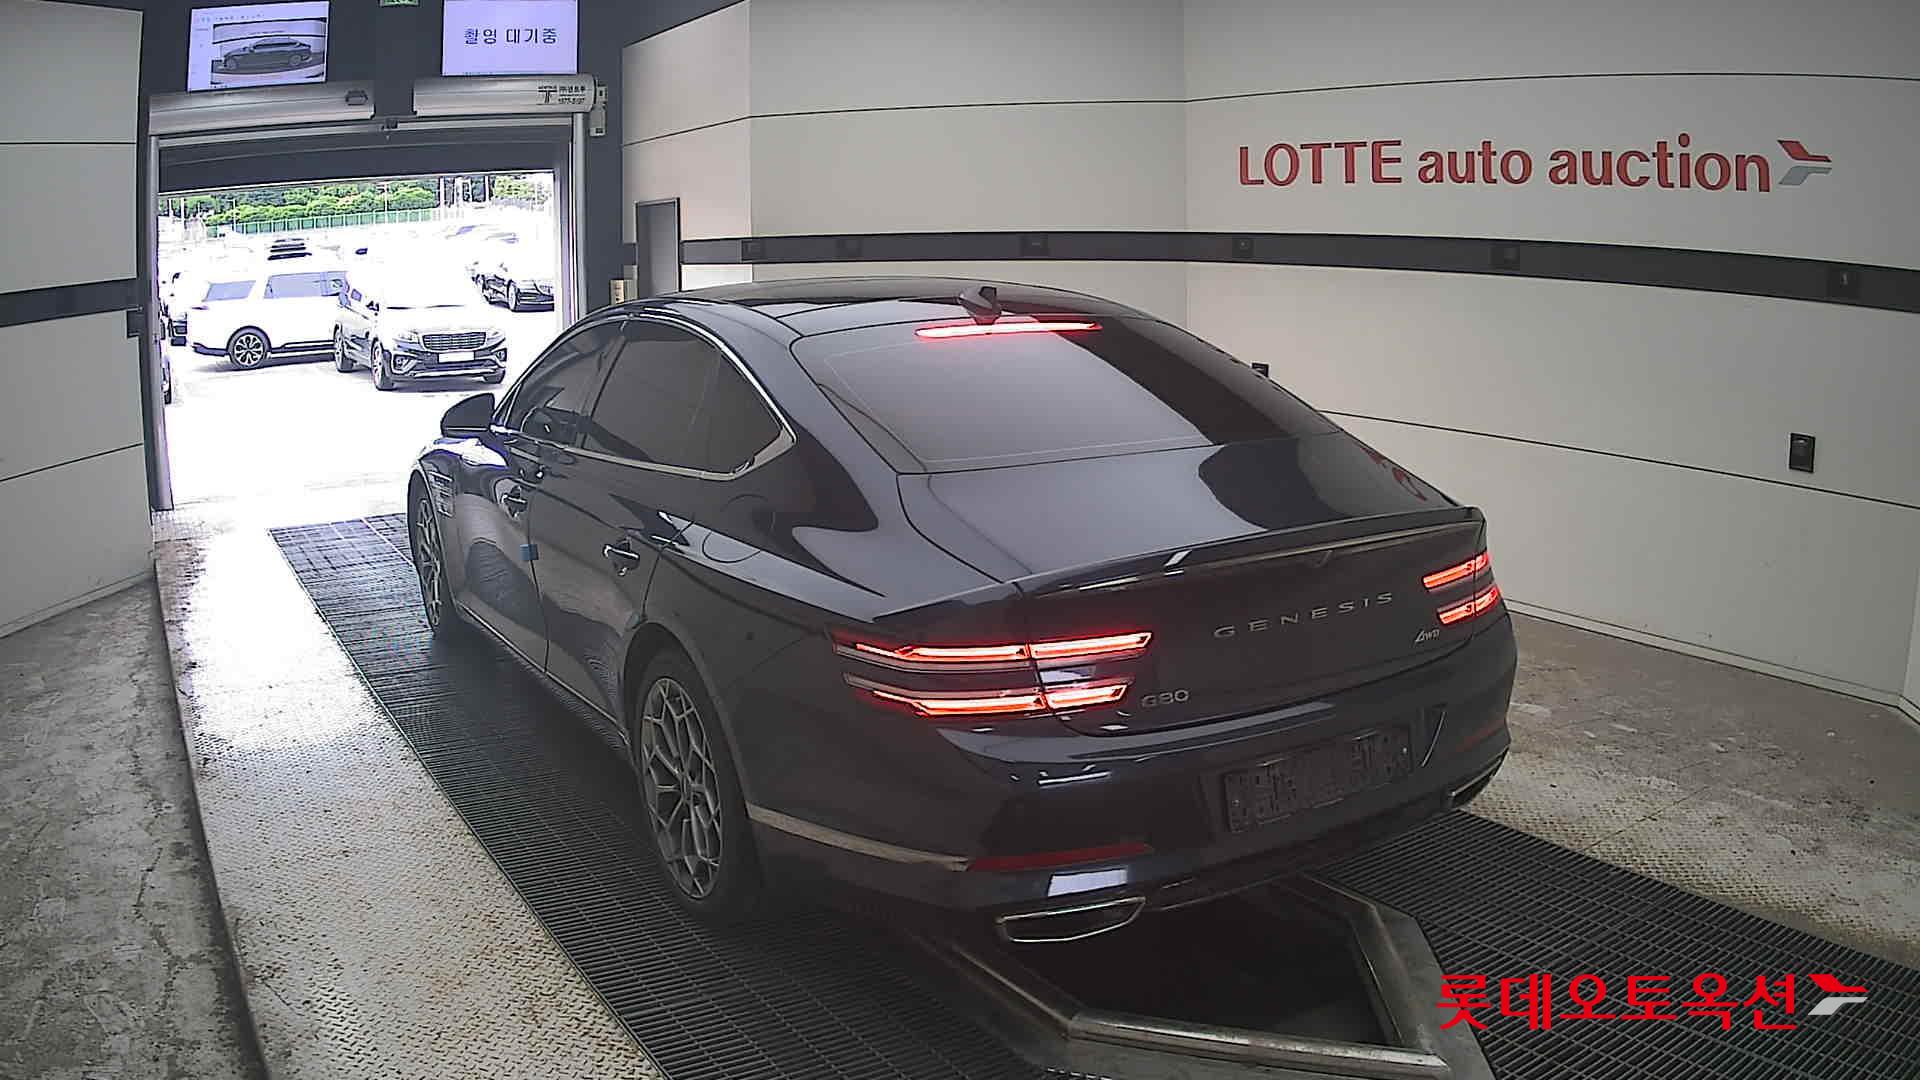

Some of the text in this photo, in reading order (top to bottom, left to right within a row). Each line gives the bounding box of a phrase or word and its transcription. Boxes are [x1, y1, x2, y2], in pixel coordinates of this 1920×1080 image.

[505, 28, 558, 45] 대기중
[1239, 132, 1770, 193] LOTTE auto auction
[1213, 591, 1394, 638] GENESIS
